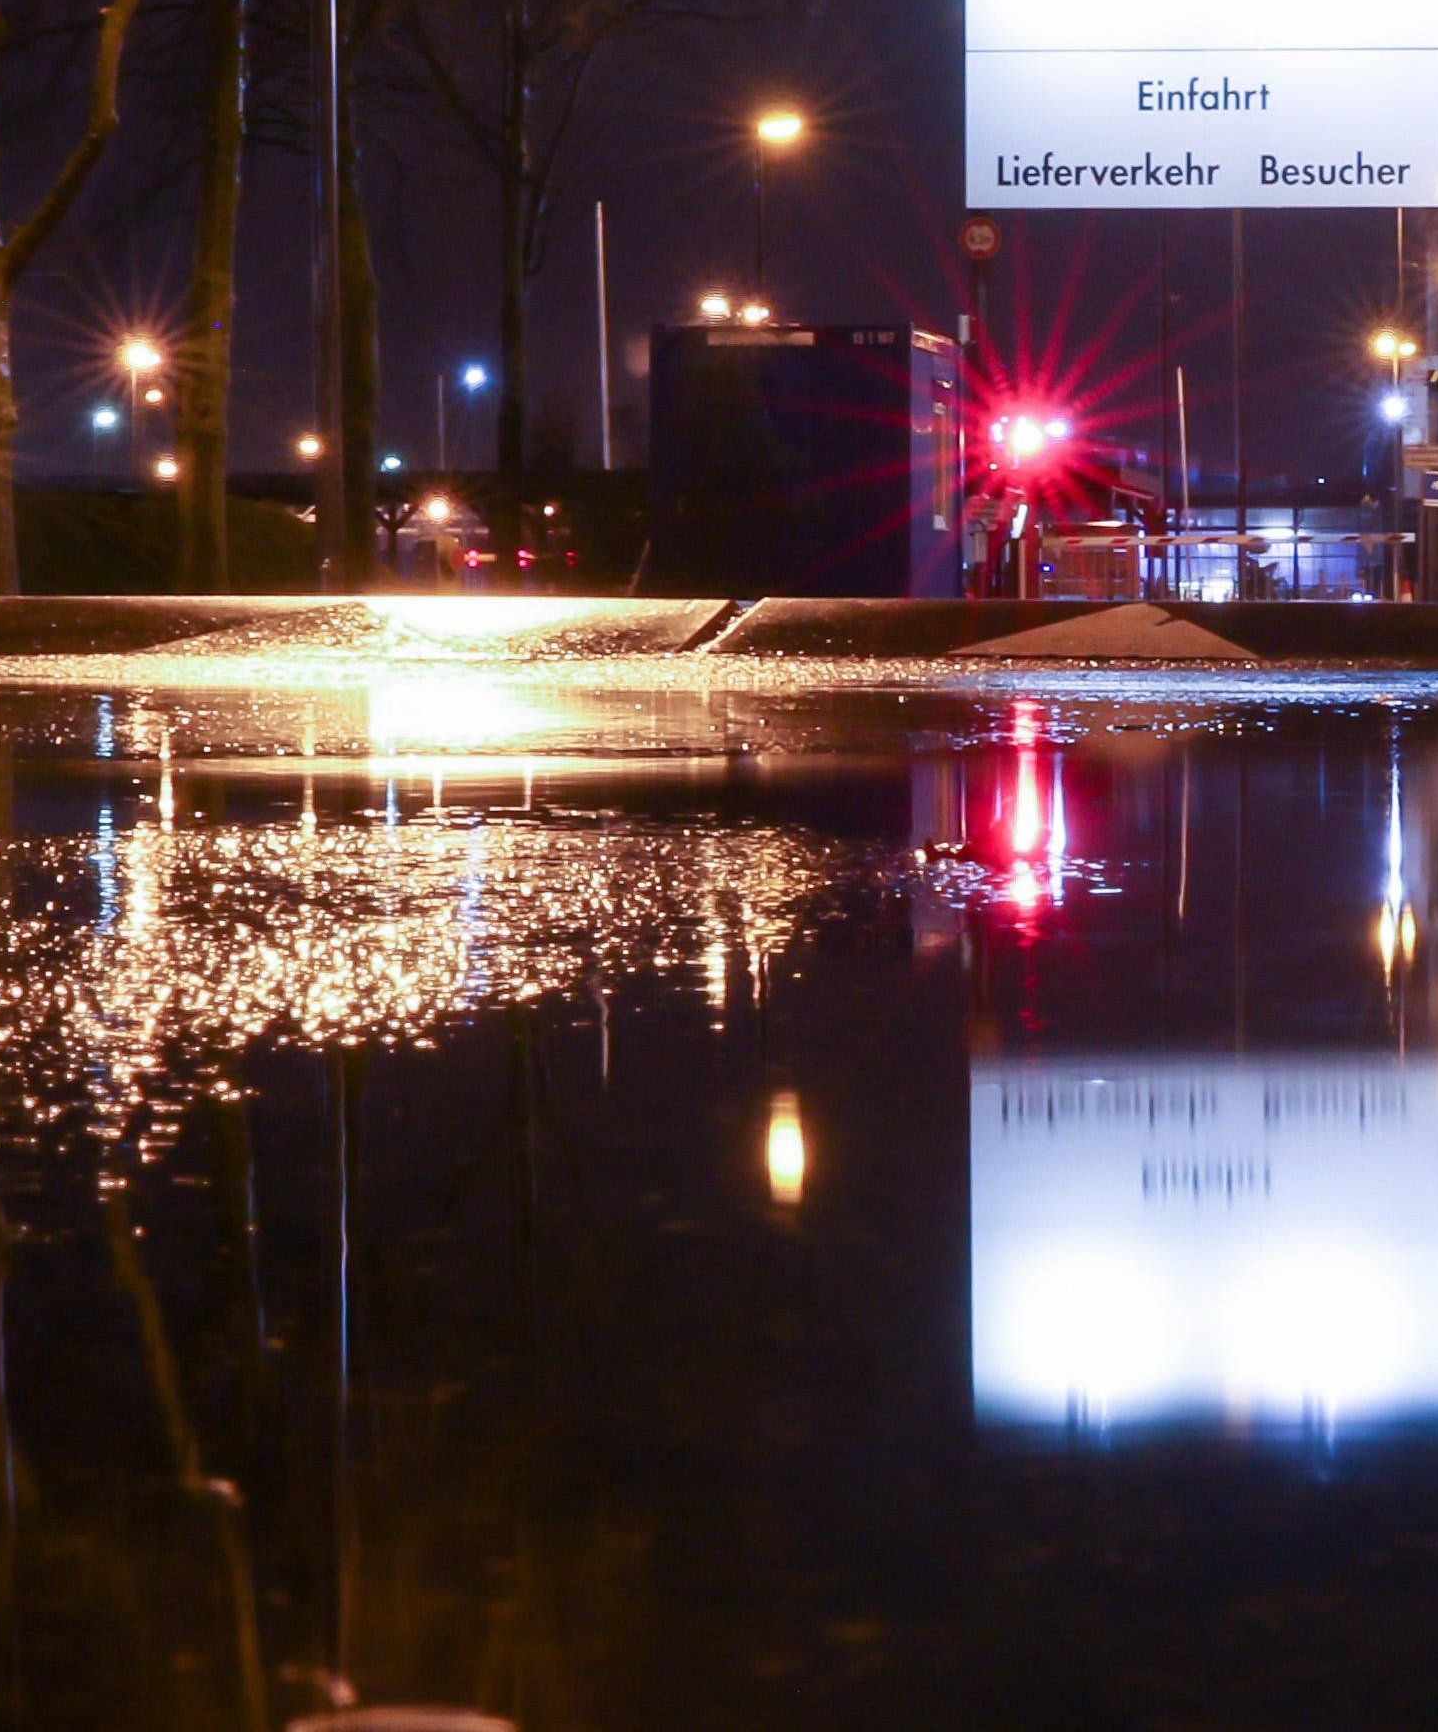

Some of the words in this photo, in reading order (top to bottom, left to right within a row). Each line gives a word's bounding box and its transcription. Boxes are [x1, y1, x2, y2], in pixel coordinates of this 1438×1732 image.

[1136, 76, 1271, 112] Einfahrt
[996, 151, 1221, 188] Lieferverkehr
[1259, 150, 1411, 187] Besucher
